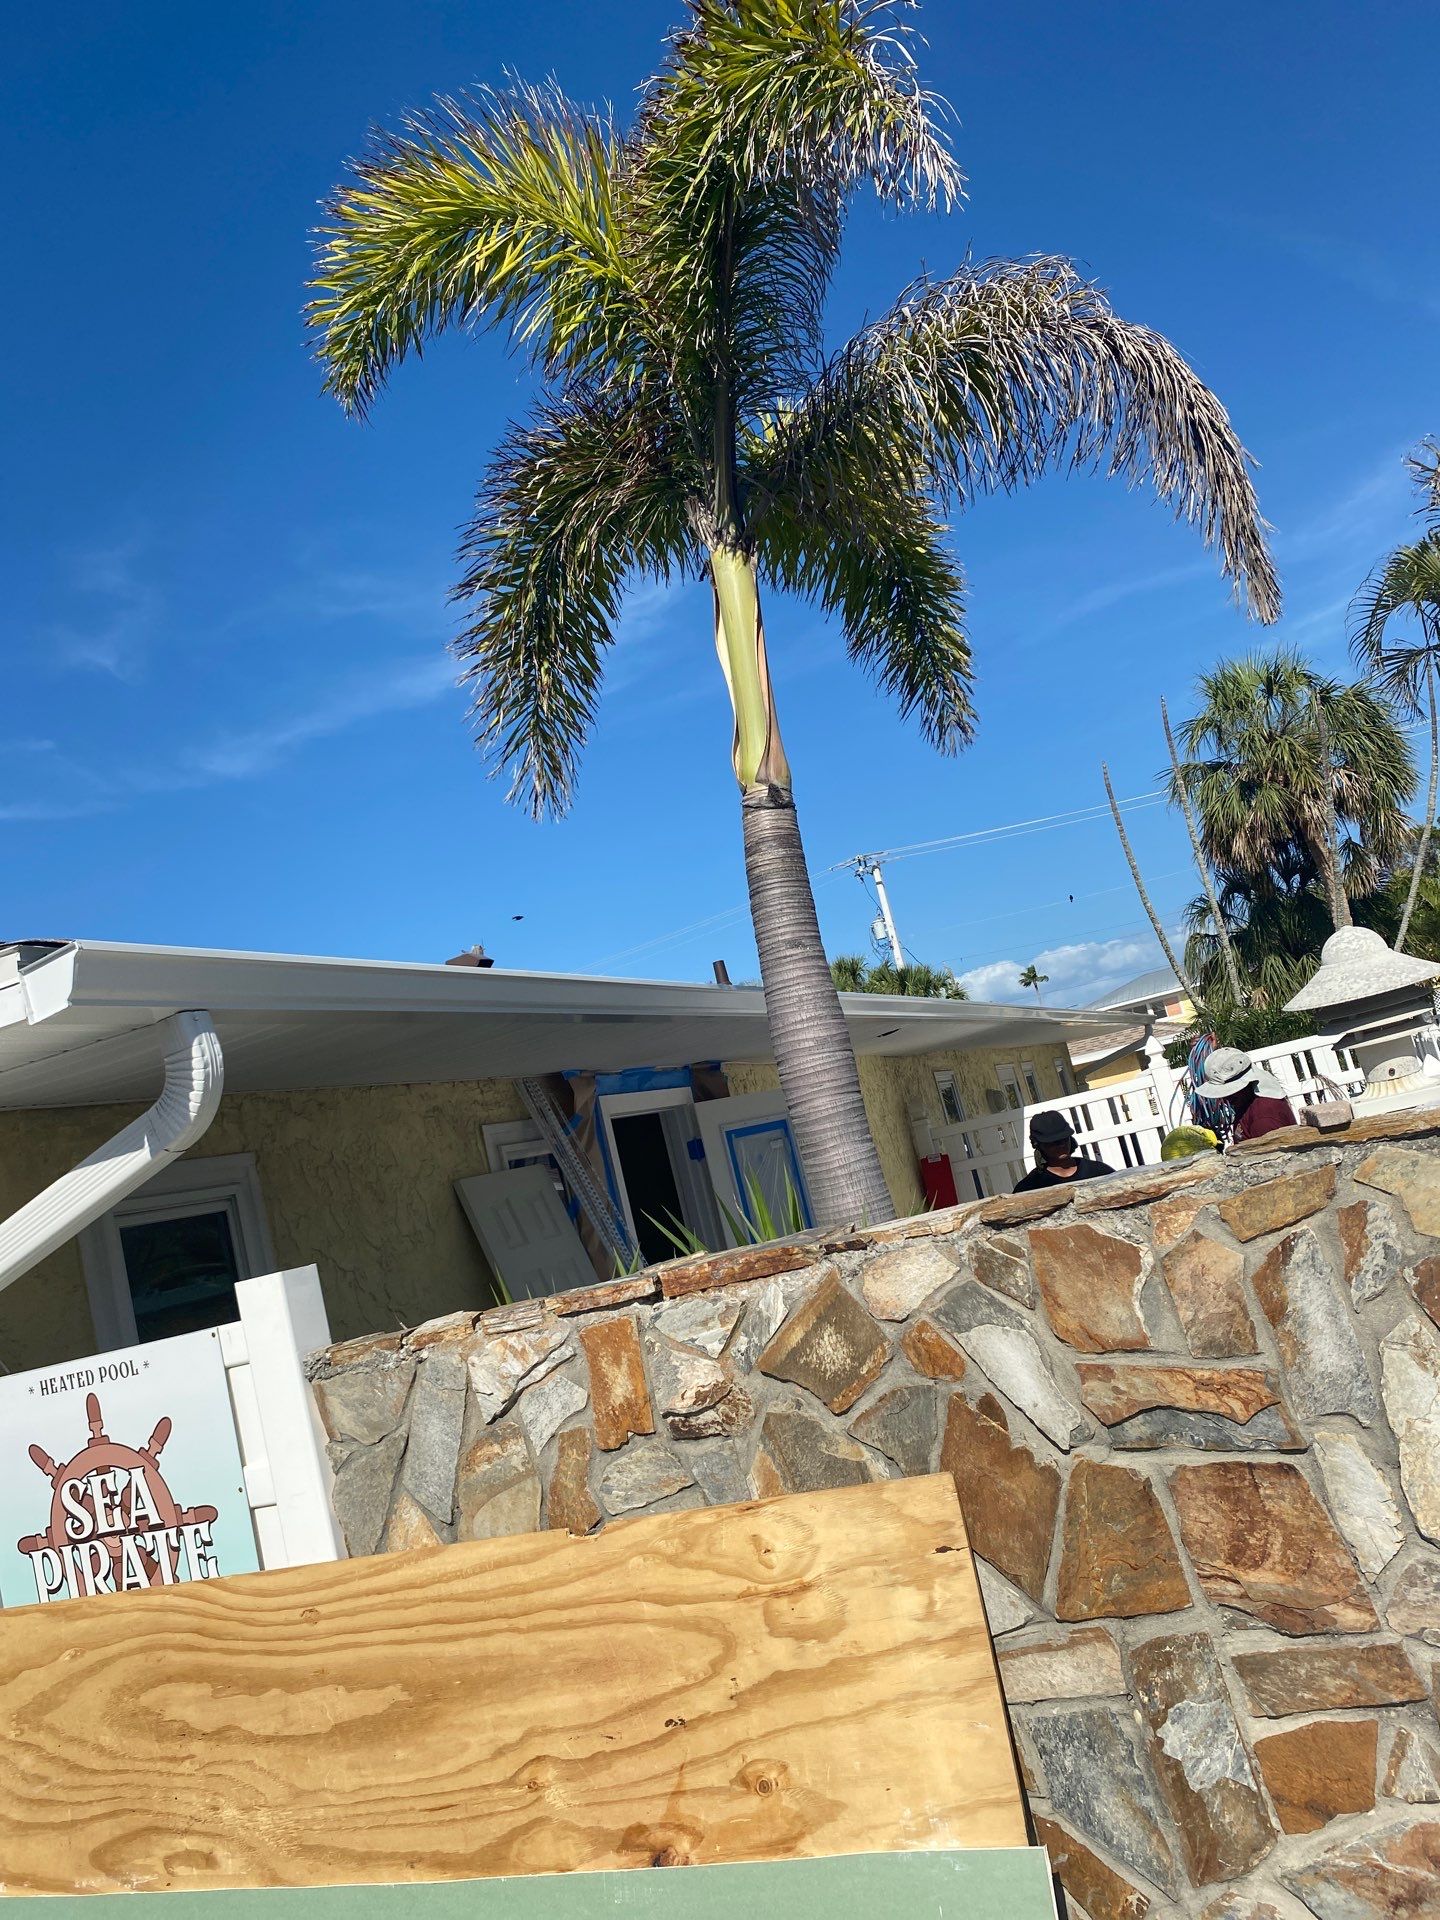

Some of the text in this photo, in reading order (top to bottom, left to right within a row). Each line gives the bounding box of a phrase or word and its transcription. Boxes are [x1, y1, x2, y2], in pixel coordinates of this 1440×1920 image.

[39, 1360, 139, 1396] HEATED POOL
[60, 1466, 164, 1541] SEA
[28, 1520, 220, 1604] PIRATE
